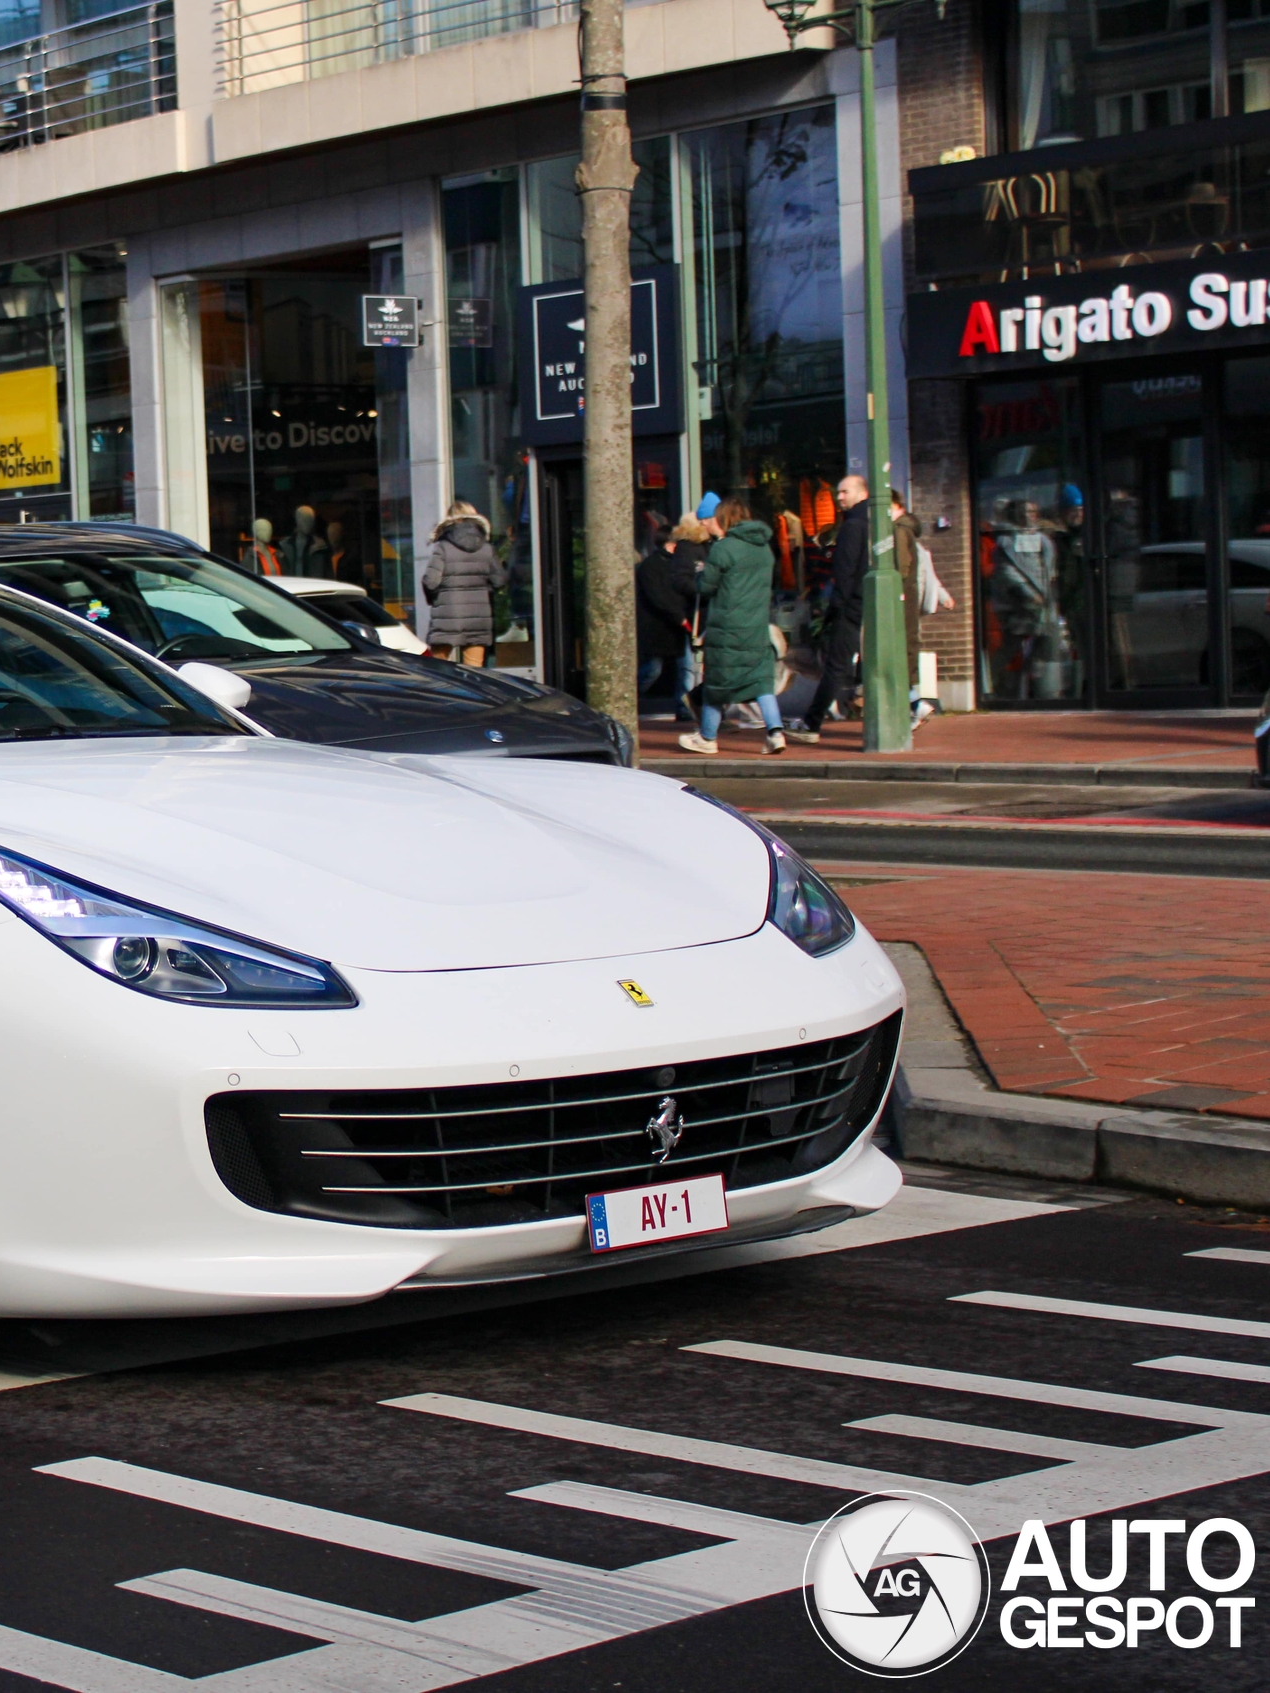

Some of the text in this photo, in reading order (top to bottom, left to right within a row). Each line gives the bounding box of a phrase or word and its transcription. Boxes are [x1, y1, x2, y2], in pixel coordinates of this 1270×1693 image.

[958, 272, 1270, 362] Arigato Su
[545, 362, 576, 377] NEW
[207, 430, 246, 454] ive
[252, 429, 283, 450] to
[642, 1189, 691, 1231] AY-1
[595, 1228, 607, 1246] B
